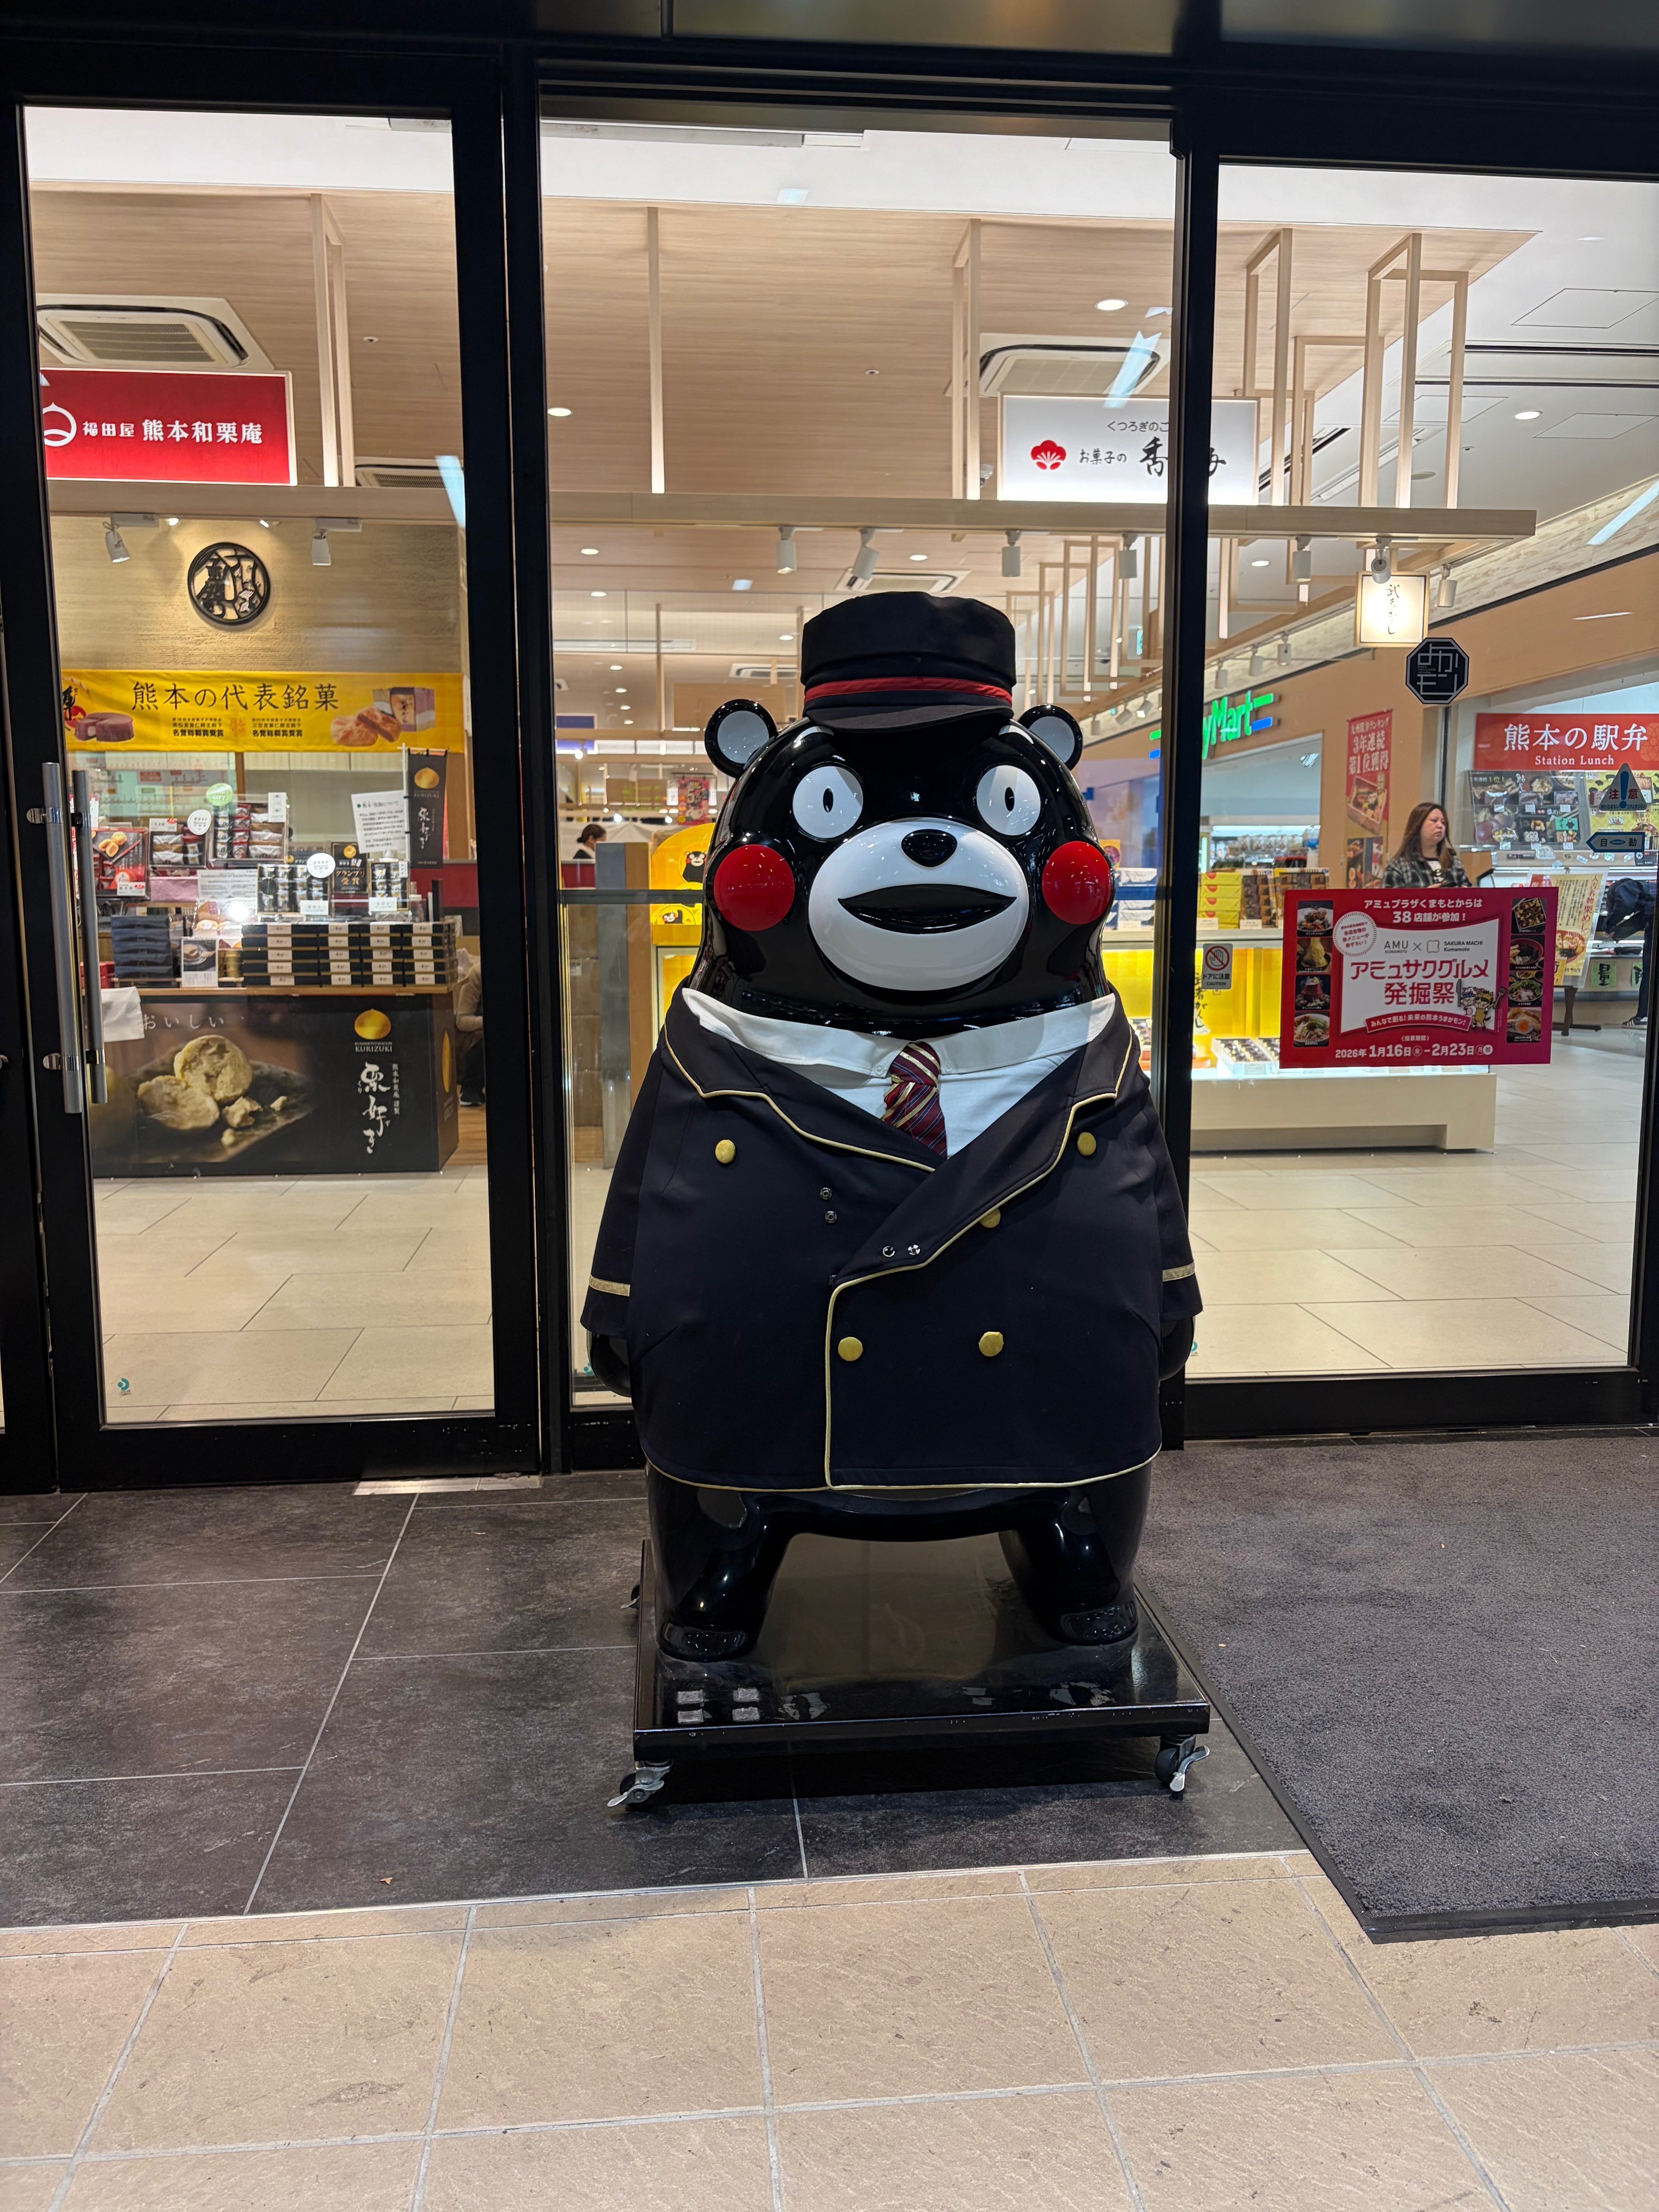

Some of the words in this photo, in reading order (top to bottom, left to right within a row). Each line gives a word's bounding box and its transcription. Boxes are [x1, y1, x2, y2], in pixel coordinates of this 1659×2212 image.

[82, 421, 135, 437] 福田屋
[142, 419, 263, 444] 熊本和栗庵
[132, 681, 339, 711] 熊本の代表銘菓
[1504, 723, 1648, 752] 熊本の駅弁
[1535, 755, 1575, 765] Station
[1580, 754, 1614, 765] Lunch
[1364, 898, 1483, 908] アミュプラザくまもとからは
[1384, 940, 1408, 949] AMU
[1350, 958, 1489, 980] アミュサクグルメ
[1384, 982, 1455, 1005] 発掘祭
